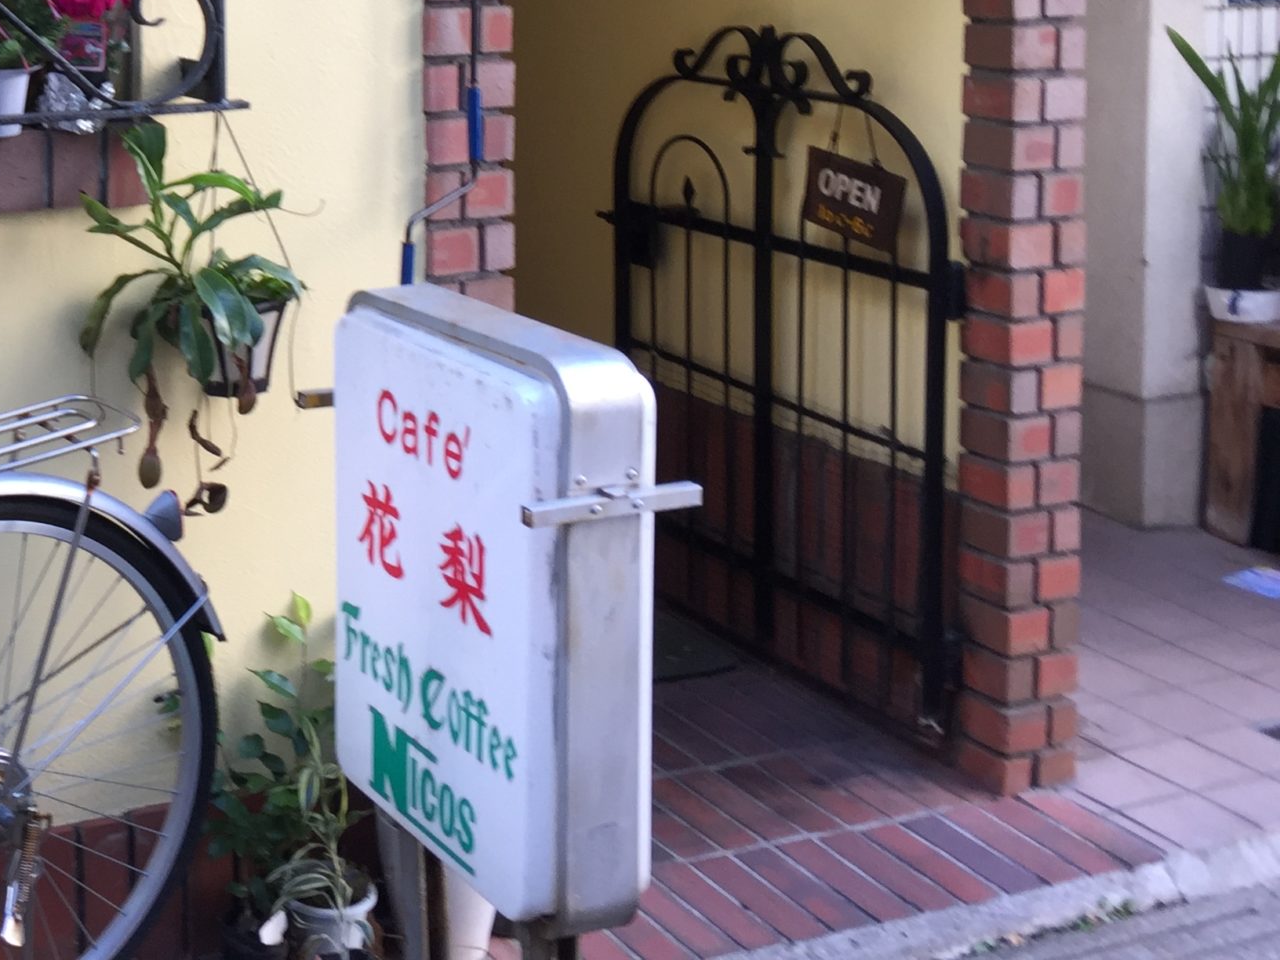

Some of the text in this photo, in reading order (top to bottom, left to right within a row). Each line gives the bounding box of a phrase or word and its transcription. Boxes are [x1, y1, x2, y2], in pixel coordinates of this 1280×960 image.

[817, 167, 882, 215] OPEN
[358, 480, 493, 638] 花梨
[341, 600, 518, 782] Fresh Coffee
